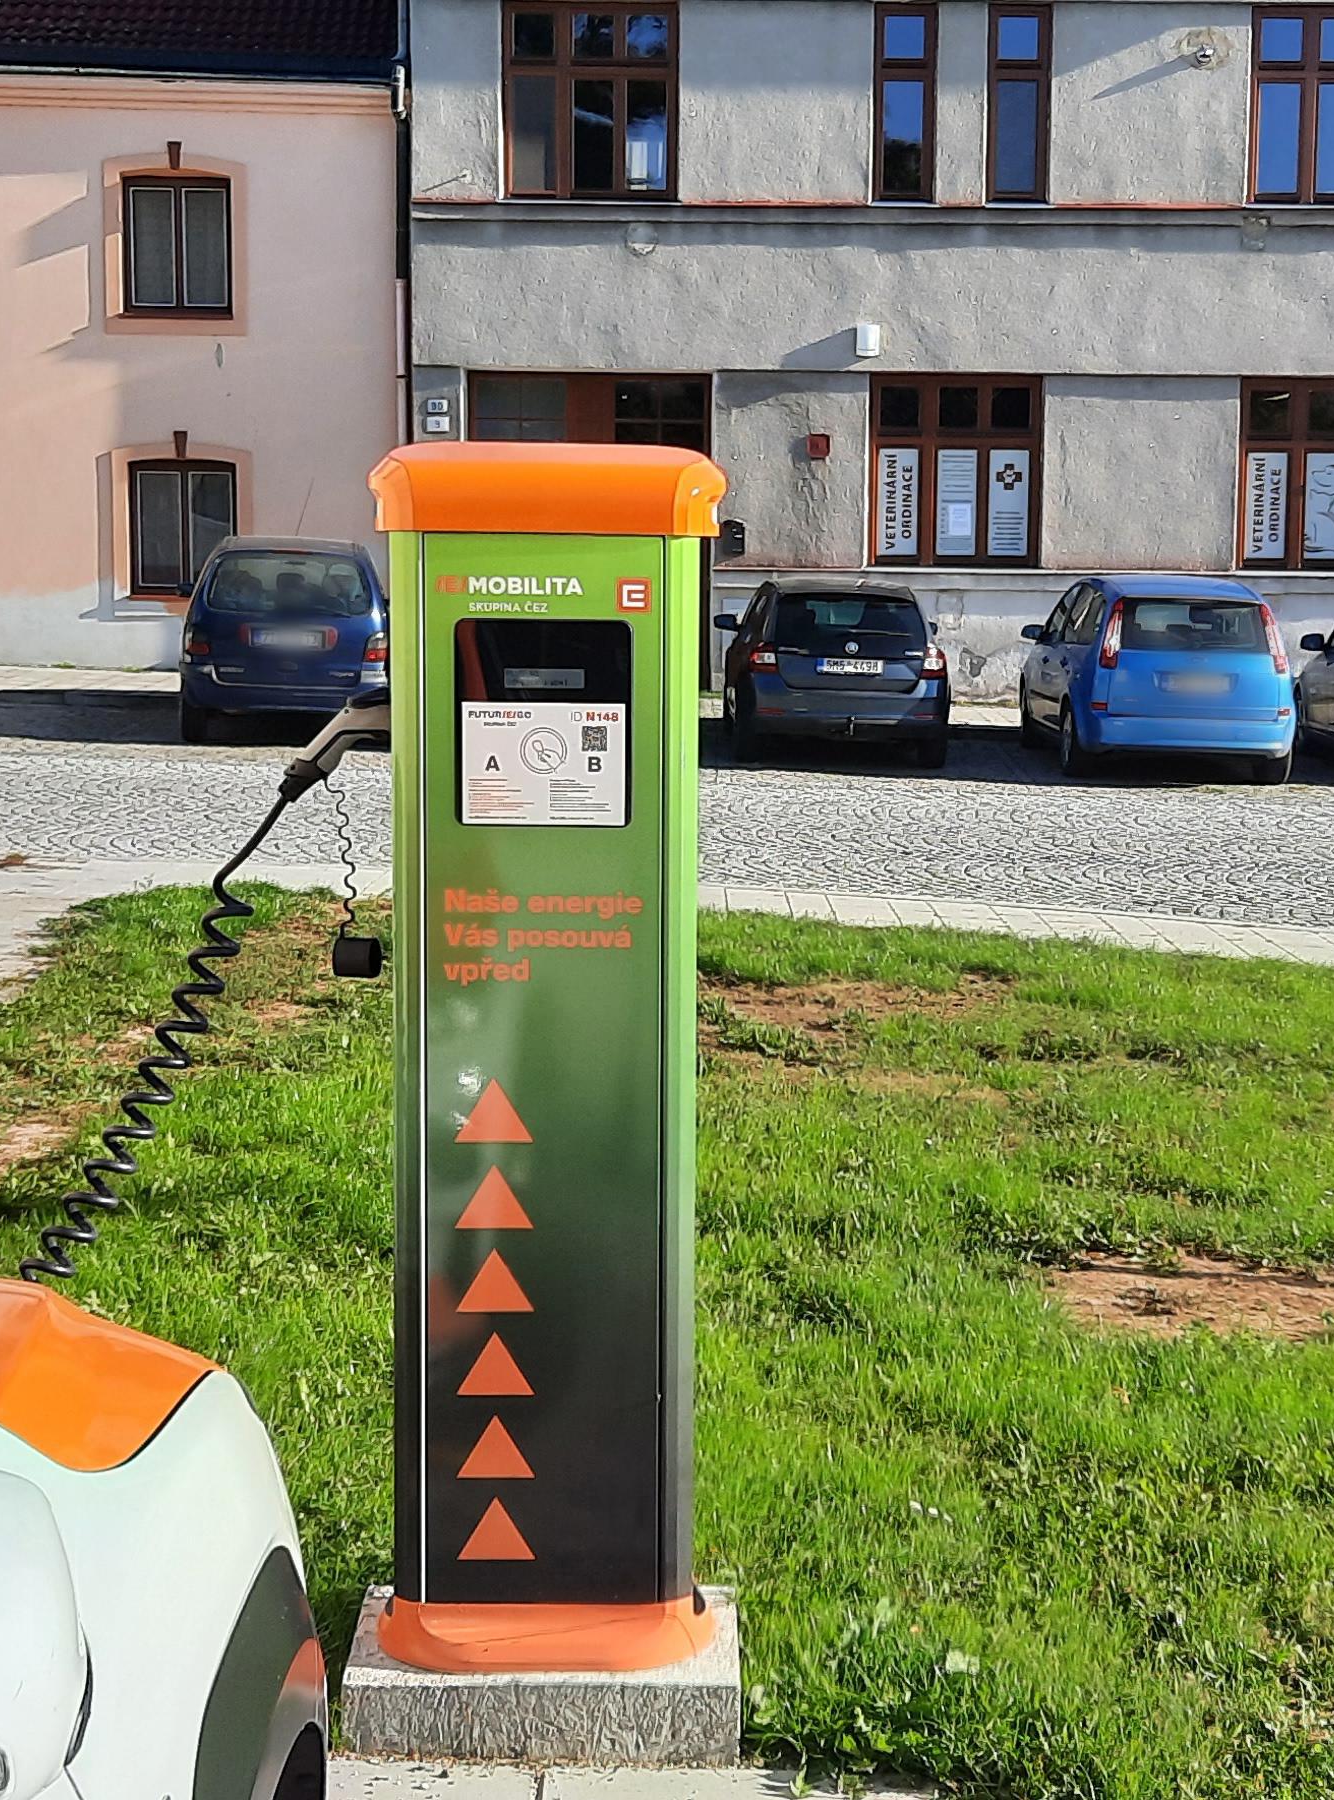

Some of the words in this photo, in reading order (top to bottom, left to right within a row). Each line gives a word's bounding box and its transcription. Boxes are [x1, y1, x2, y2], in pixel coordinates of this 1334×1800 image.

[885, 454, 897, 551] VETERINÁRNÍ
[901, 465, 913, 539] ORDINACE
[1252, 457, 1266, 554] VETERINÁRNÍ
[1268, 468, 1282, 542] ORDINACE
[468, 602, 520, 614] SKUPINA
[524, 600, 548, 614] ČEZ
[570, 711, 583, 722] ID
[485, 755, 500, 771] A
[588, 756, 602, 772] B
[444, 888, 519, 913] Naše
[527, 891, 643, 920] energie
[444, 922, 499, 948] Vás
[507, 924, 632, 951] posouvá
[444, 957, 531, 986] vpřed
